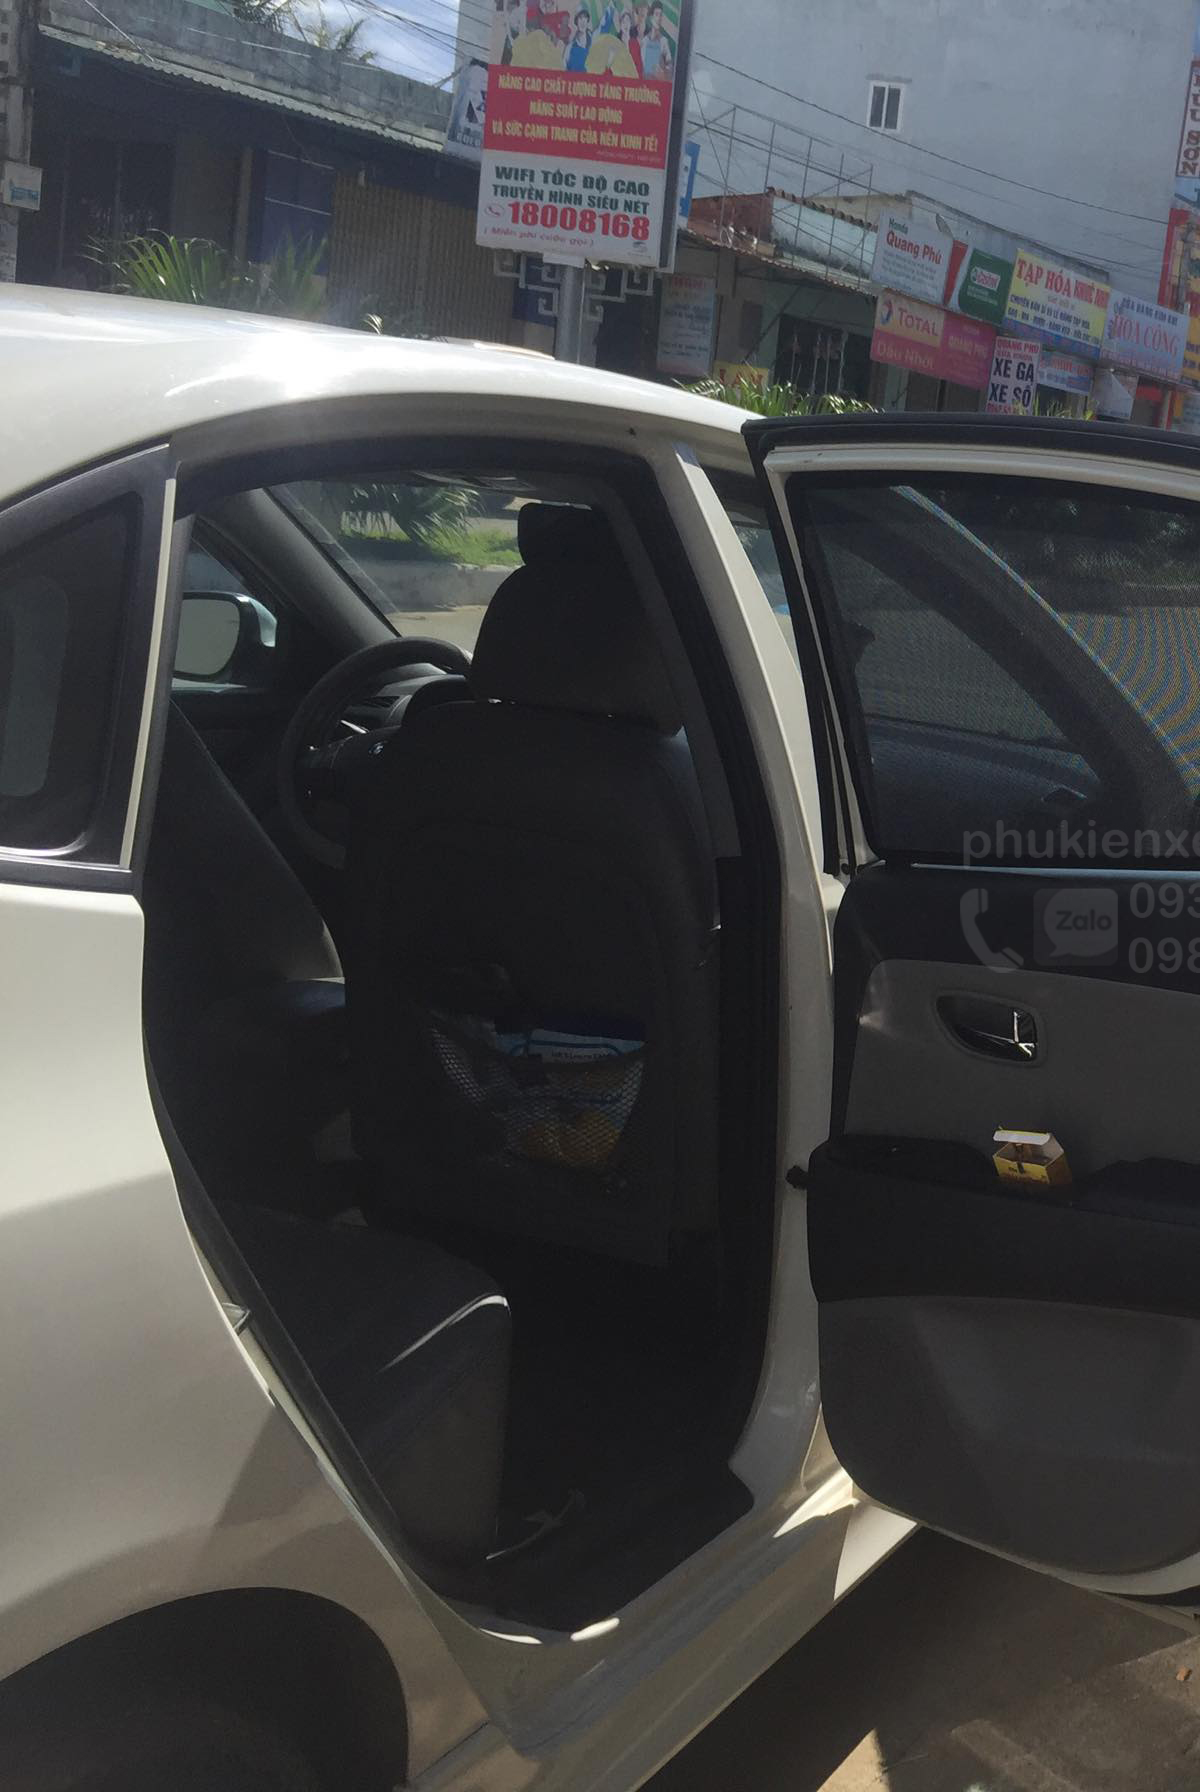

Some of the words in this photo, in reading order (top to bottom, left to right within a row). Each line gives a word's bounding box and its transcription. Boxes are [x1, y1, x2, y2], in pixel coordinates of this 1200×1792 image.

[525, 77, 541, 91] CAO
[580, 107, 596, 122] LAO
[620, 134, 642, 150] KINH
[495, 165, 535, 183] WIFI
[541, 168, 576, 188] TỐC
[582, 174, 607, 193] ĐỘ
[613, 179, 650, 197] CAO
[492, 183, 544, 201] TRUYỀN
[549, 190, 583, 205] HÌNH
[587, 193, 618, 211] SIÊU
[623, 197, 650, 215] NÉT
[508, 201, 650, 241] 18008168
[887, 230, 920, 259] Quang
[922, 244, 943, 265] Phú
[1017, 258, 1043, 288] TẠP
[1046, 267, 1072, 298] HÓA
[898, 307, 938, 336] TOTAL
[993, 358, 1012, 378] XE
[1016, 361, 1034, 382] GA
[989, 382, 1008, 403] XE
